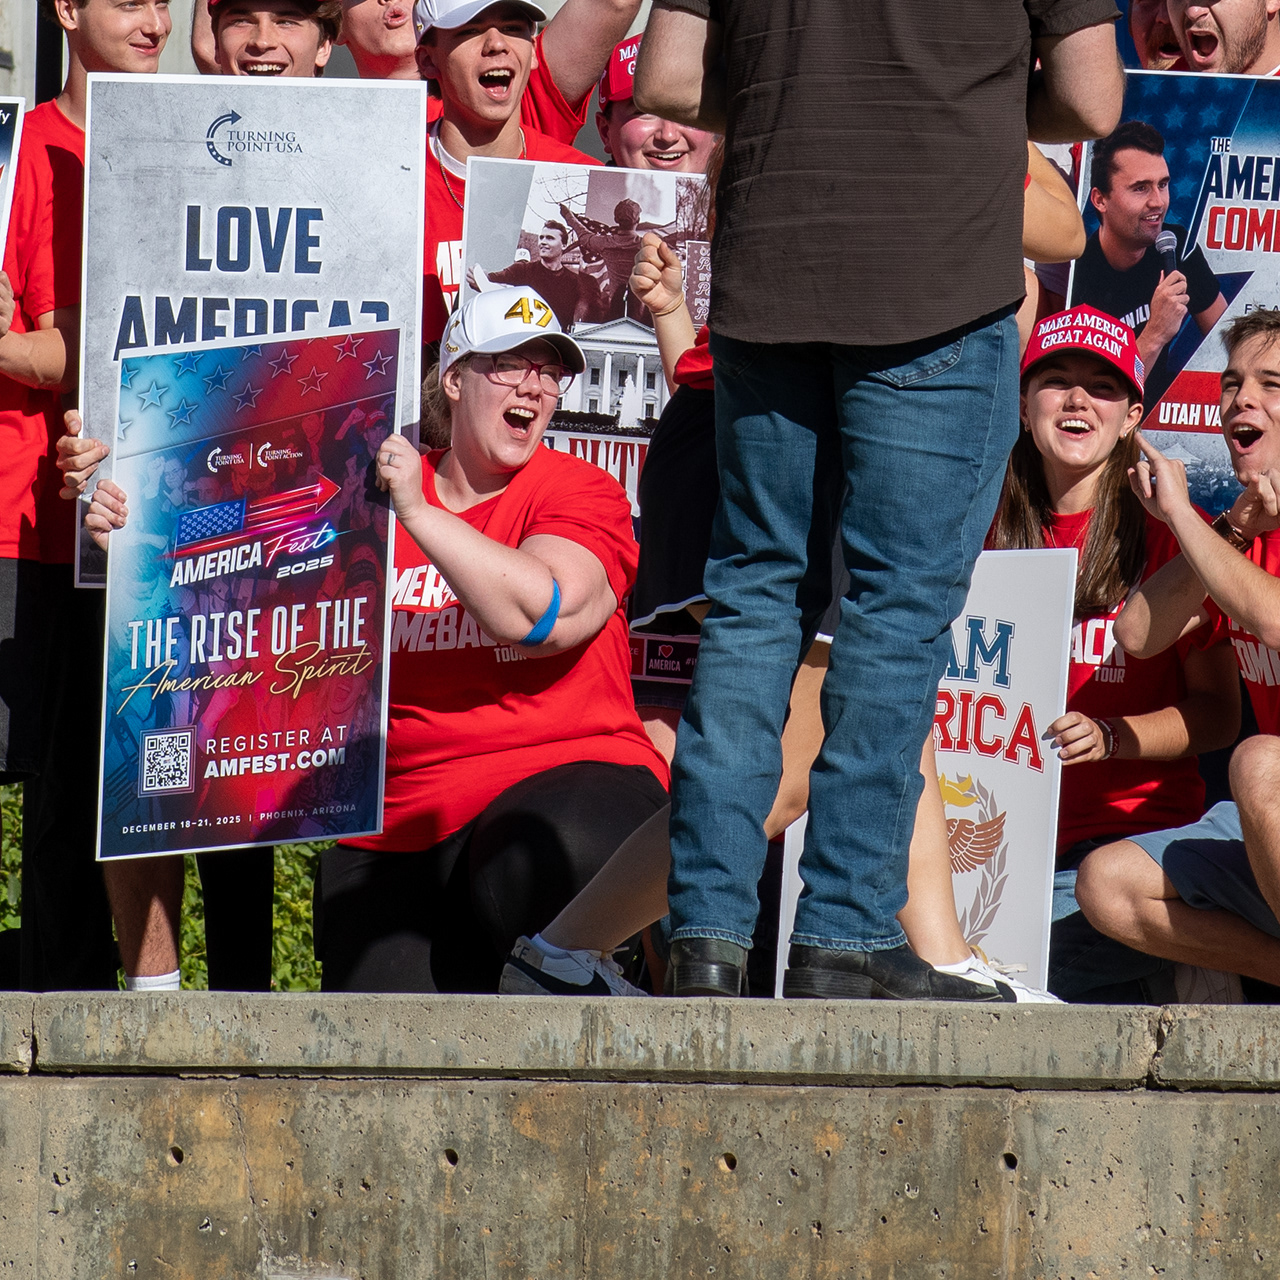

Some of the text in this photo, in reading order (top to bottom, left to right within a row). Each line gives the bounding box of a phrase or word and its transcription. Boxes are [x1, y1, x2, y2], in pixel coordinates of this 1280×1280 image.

[619, 42, 641, 62] MA
[228, 131, 296, 143] TURNING
[228, 142, 302, 153] POINT USA
[1212, 137, 1231, 152] THE
[186, 205, 323, 273] LOVE
[504, 296, 552, 328] 47
[1037, 314, 1073, 337] MAKE
[1073, 312, 1129, 346] AMERICA
[1040, 330, 1122, 358] GREAT AGAIN
[1159, 402, 1201, 426] UTAH
[170, 521, 340, 588] AMERICA Fest
[277, 555, 333, 579] 2025
[128, 597, 367, 669] THE RISE OF THE
[117, 641, 373, 715] American Spirit
[649, 659, 681, 671] AMERICA
[1094, 666, 1126, 683] TOUR
[205, 726, 347, 754] REGISTER AT
[933, 688, 1045, 774] RICA
[205, 749, 345, 778] AMFEST.COM
[123, 821, 175, 834] DECEMBER
[216, 815, 241, 825] 2025
[260, 810, 308, 820] PHOENIX,
[312, 804, 356, 815] ARIZONA
